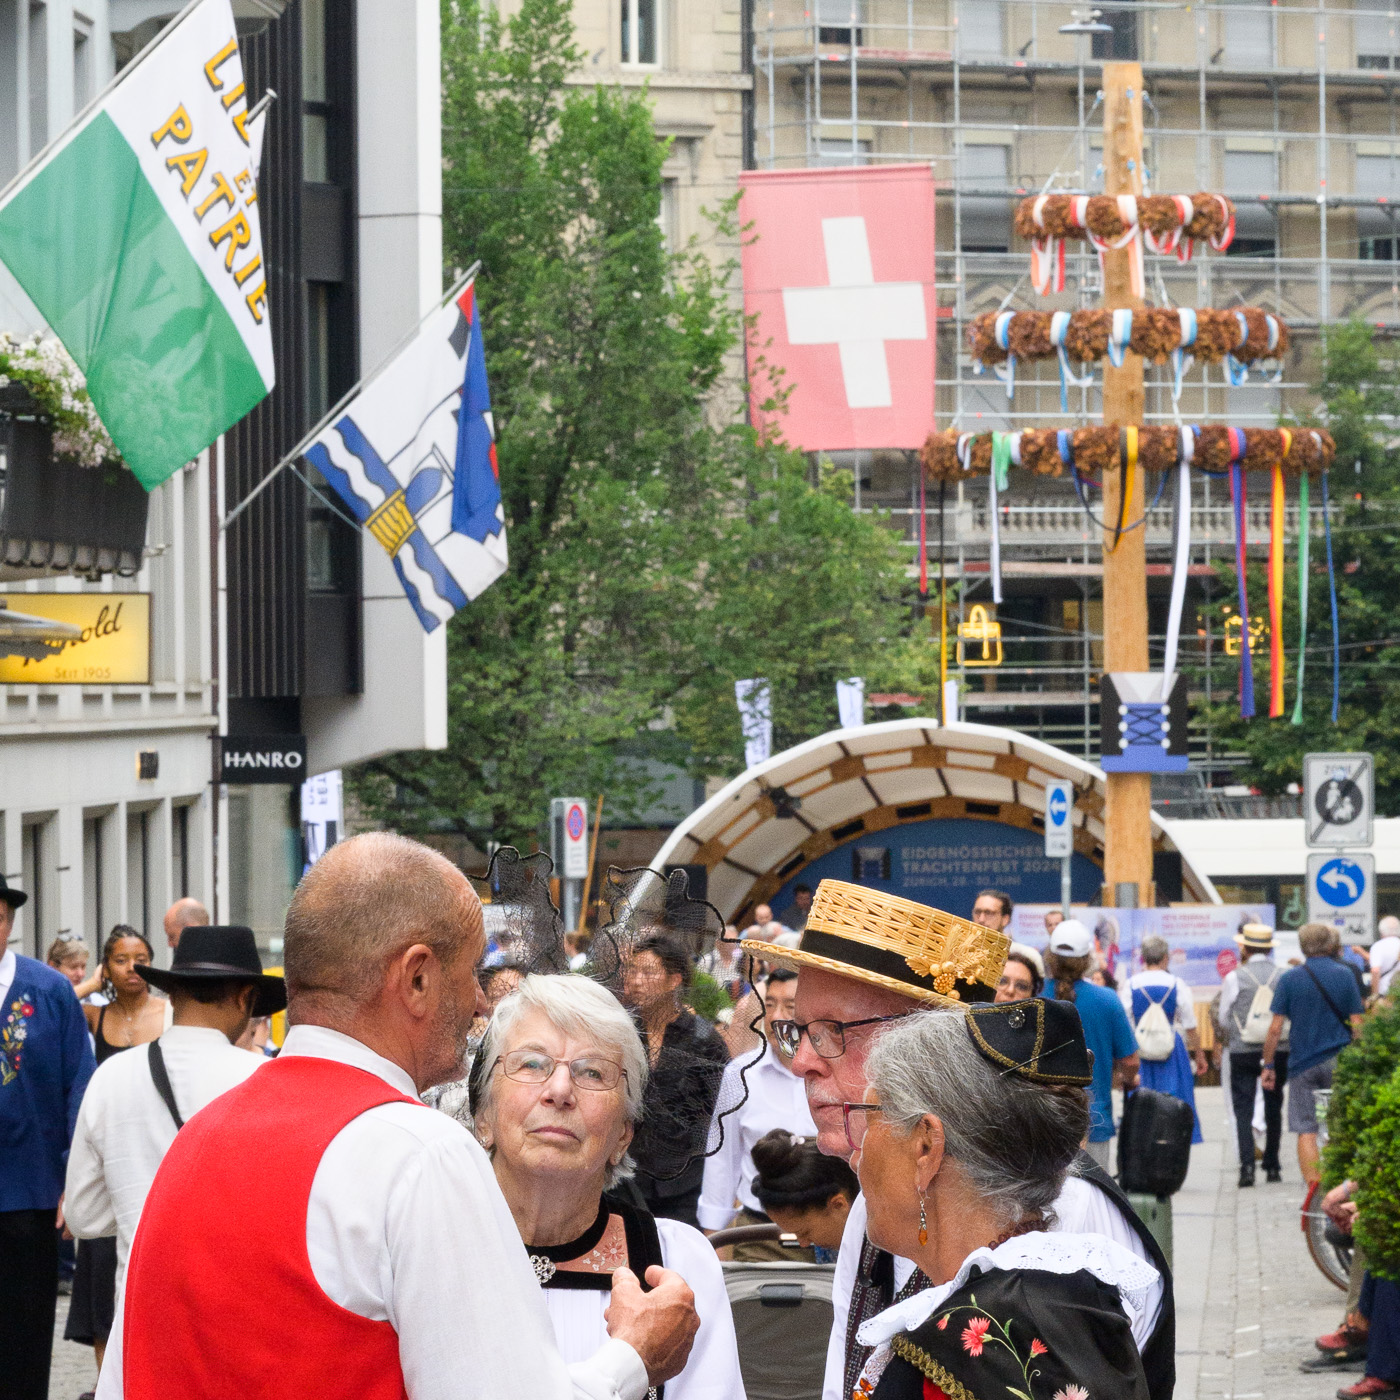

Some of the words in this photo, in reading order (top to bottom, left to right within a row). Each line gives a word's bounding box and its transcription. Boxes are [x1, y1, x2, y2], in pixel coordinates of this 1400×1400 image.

[150, 102, 268, 326] PATRIE
[83, 666, 112, 679] 1905
[224, 751, 302, 768] HANRO
[903, 861, 1019, 873] TRACHTENFEST
